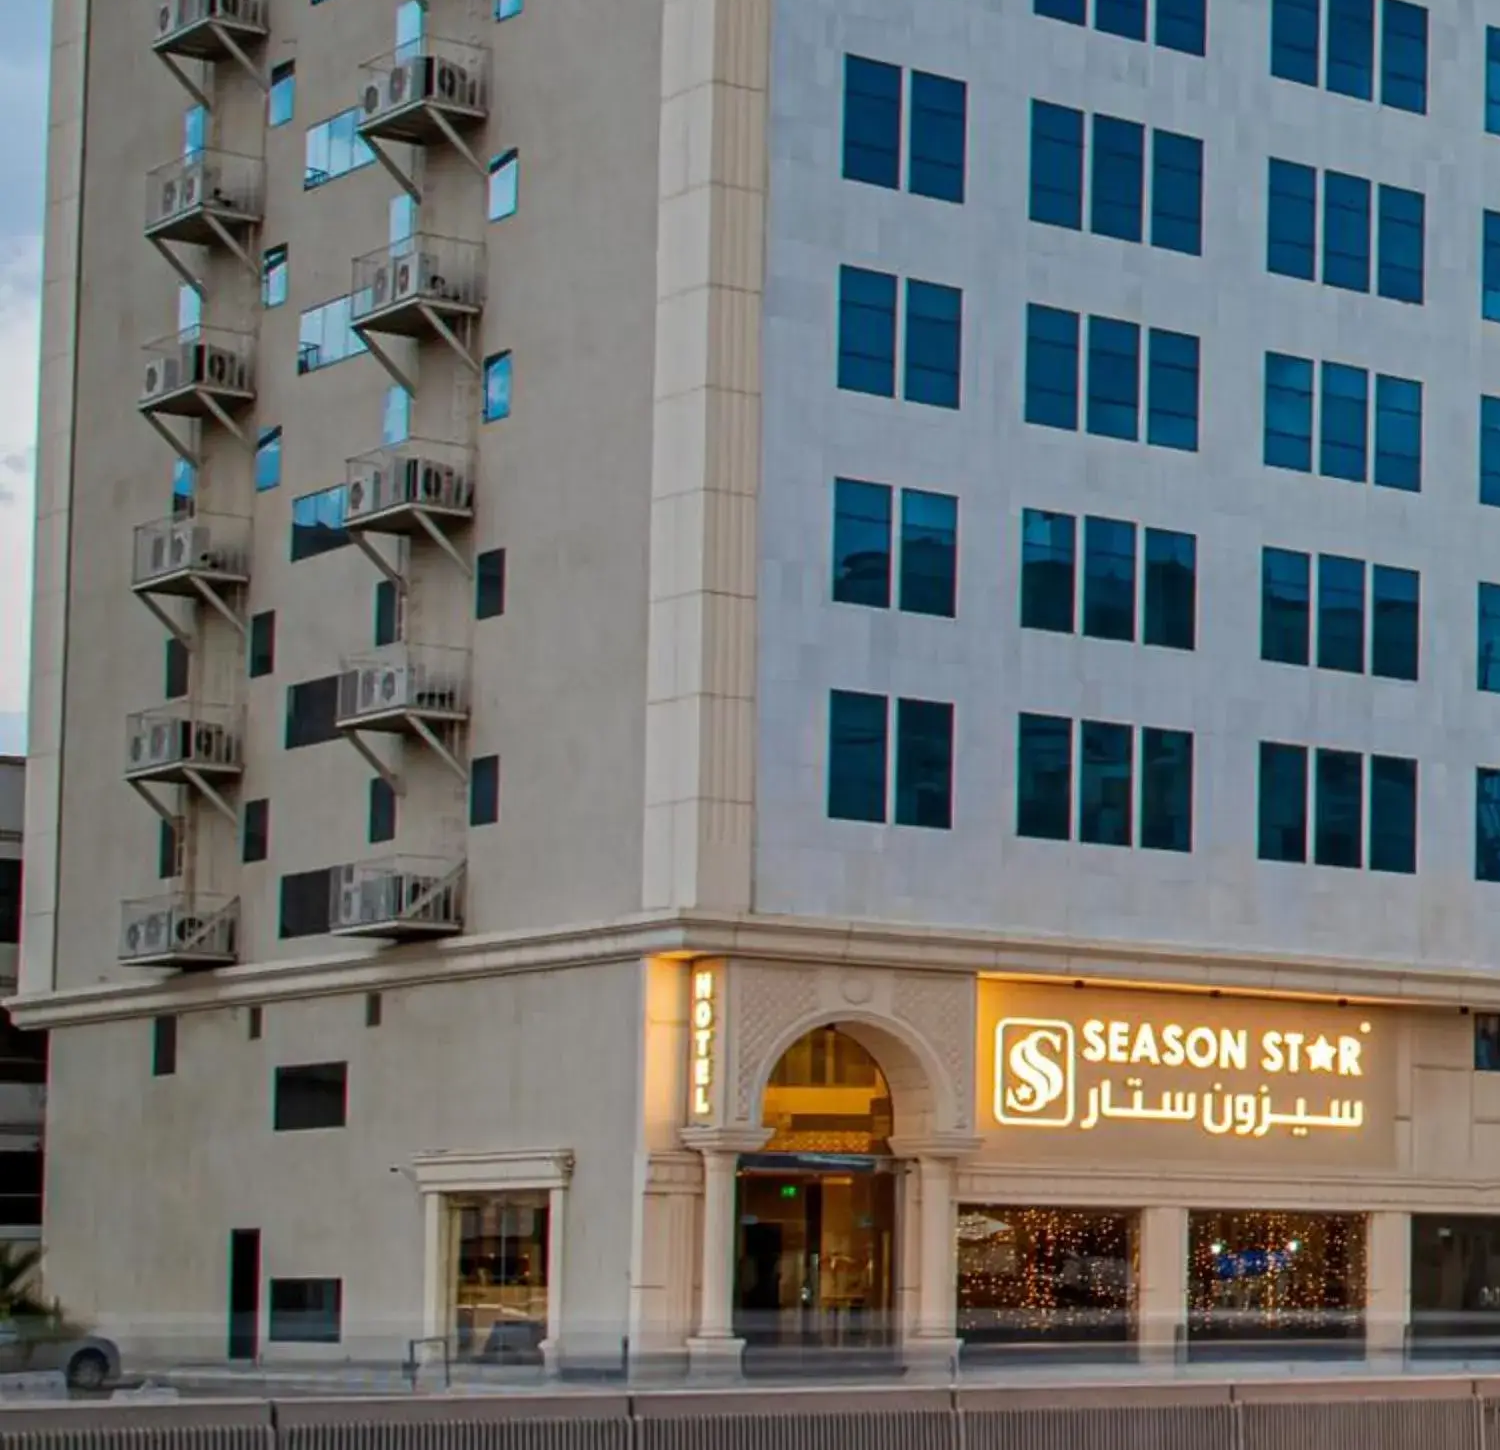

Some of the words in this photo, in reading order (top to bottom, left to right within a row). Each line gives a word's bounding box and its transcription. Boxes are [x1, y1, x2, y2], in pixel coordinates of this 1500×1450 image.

[694, 971, 712, 1114] HOTEL
[1082, 1019, 1248, 1070] SEASON
[1079, 1077, 1197, 1129] ستار
[1202, 1082, 1364, 1138] سيزون
